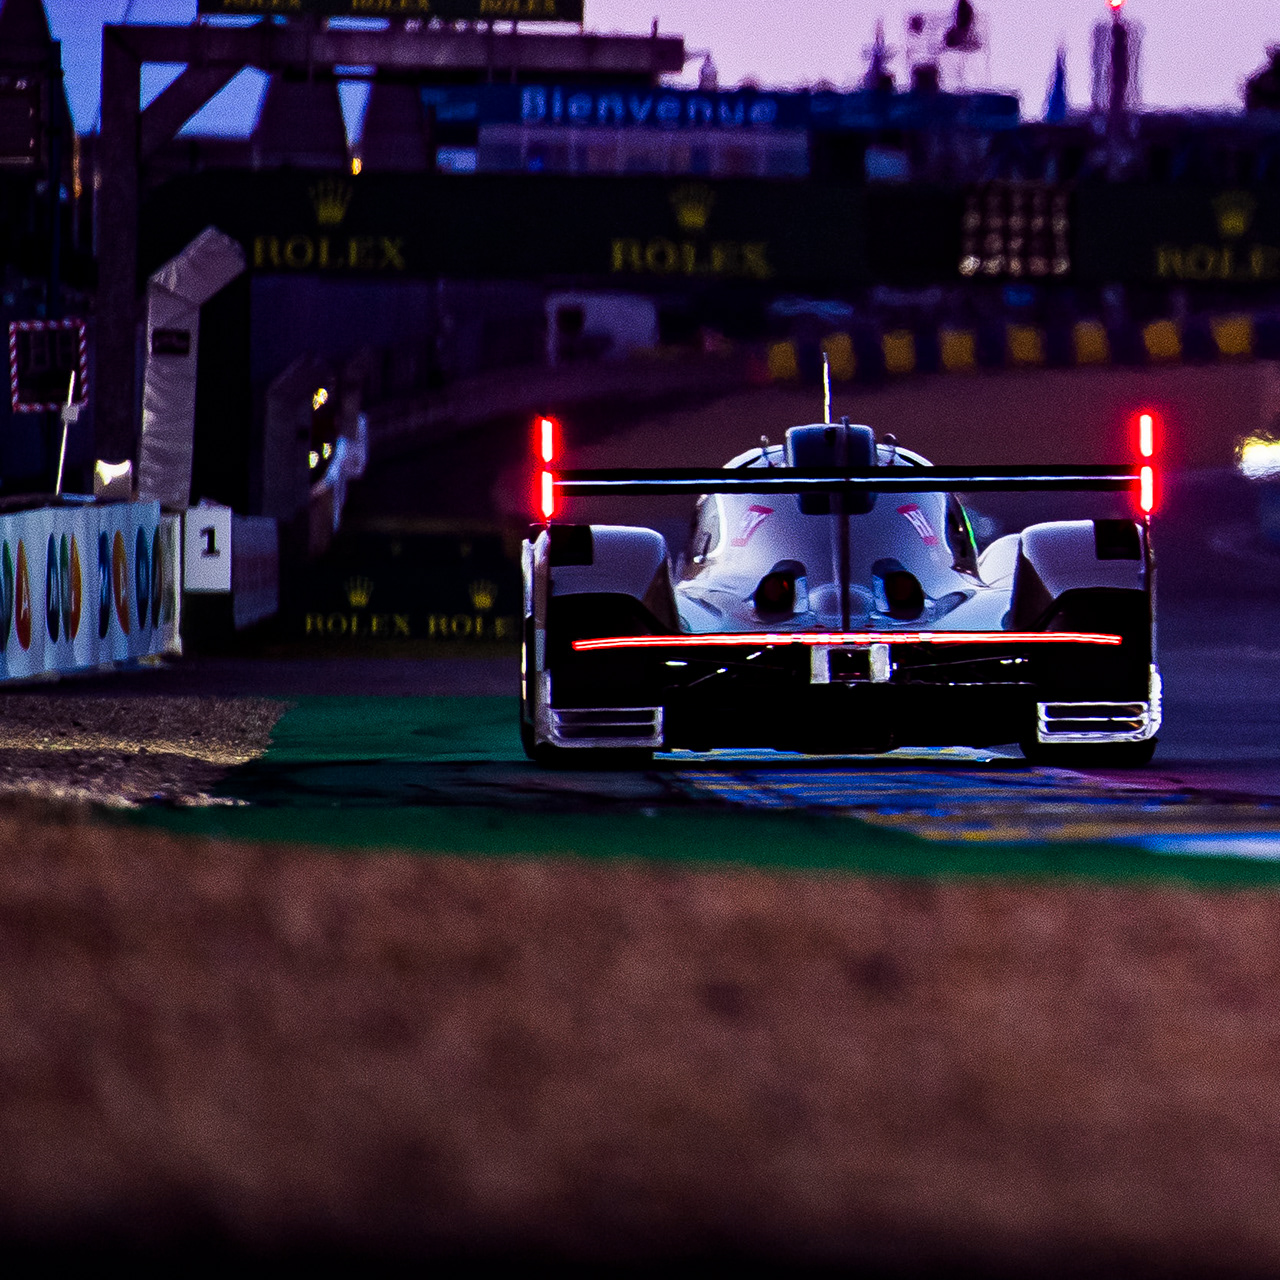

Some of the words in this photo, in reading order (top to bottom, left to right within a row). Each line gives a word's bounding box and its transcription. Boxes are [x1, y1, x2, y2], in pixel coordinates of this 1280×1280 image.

[519, 85, 779, 124] Bienvenue
[252, 233, 406, 271] ROLEX
[610, 236, 774, 278] ROLEX
[199, 526, 221, 558] 1
[303, 611, 412, 638] ROLEX
